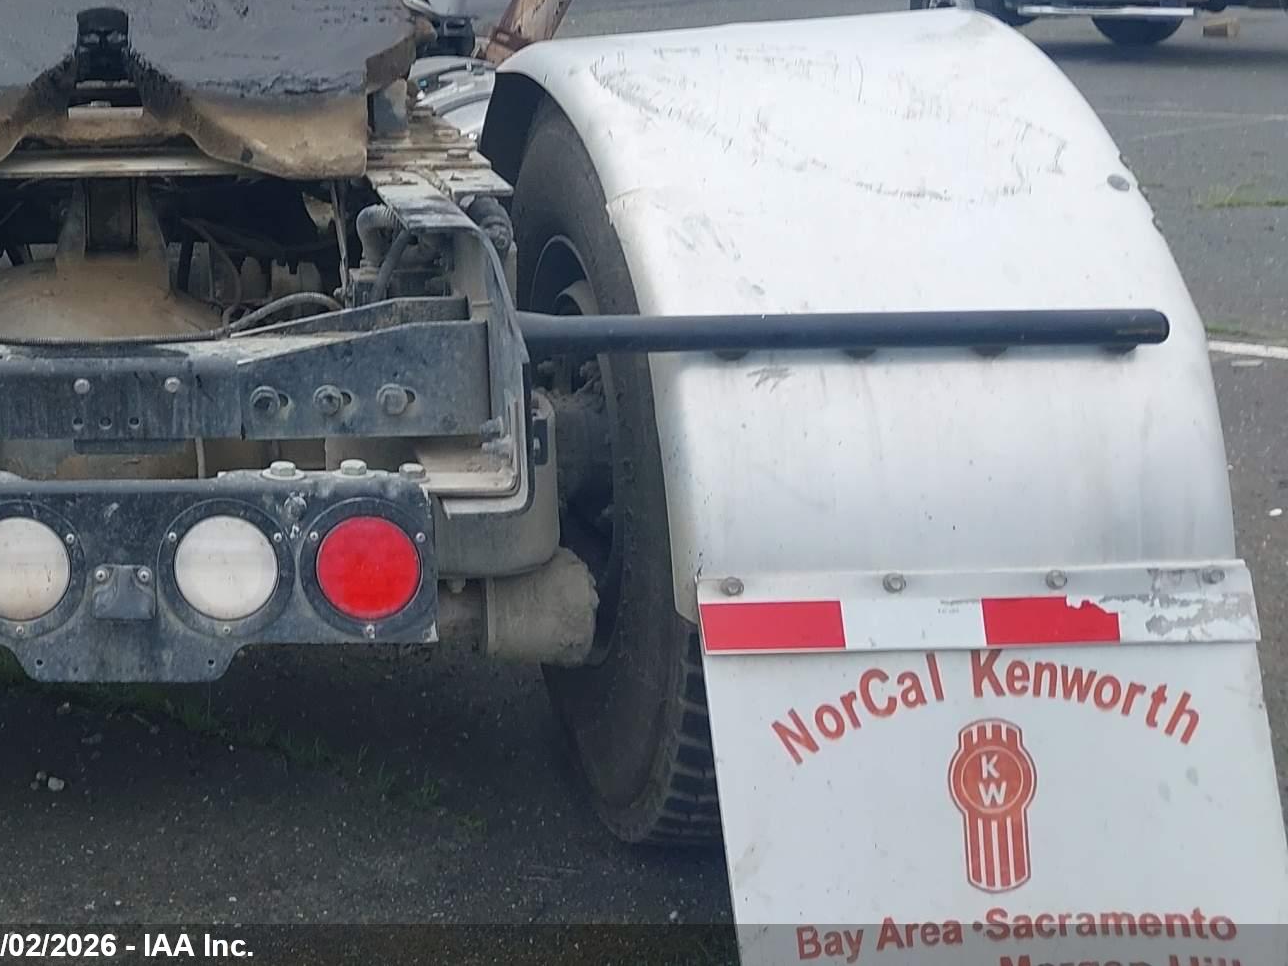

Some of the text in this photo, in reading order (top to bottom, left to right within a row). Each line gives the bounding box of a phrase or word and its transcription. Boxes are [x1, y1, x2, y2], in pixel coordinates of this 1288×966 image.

[771, 649, 1200, 765] NorCal Kenworth
[981, 755, 1000, 779] K
[978, 781, 1007, 807] W
[796, 925, 863, 963] Bay
[876, 916, 963, 951] Area
